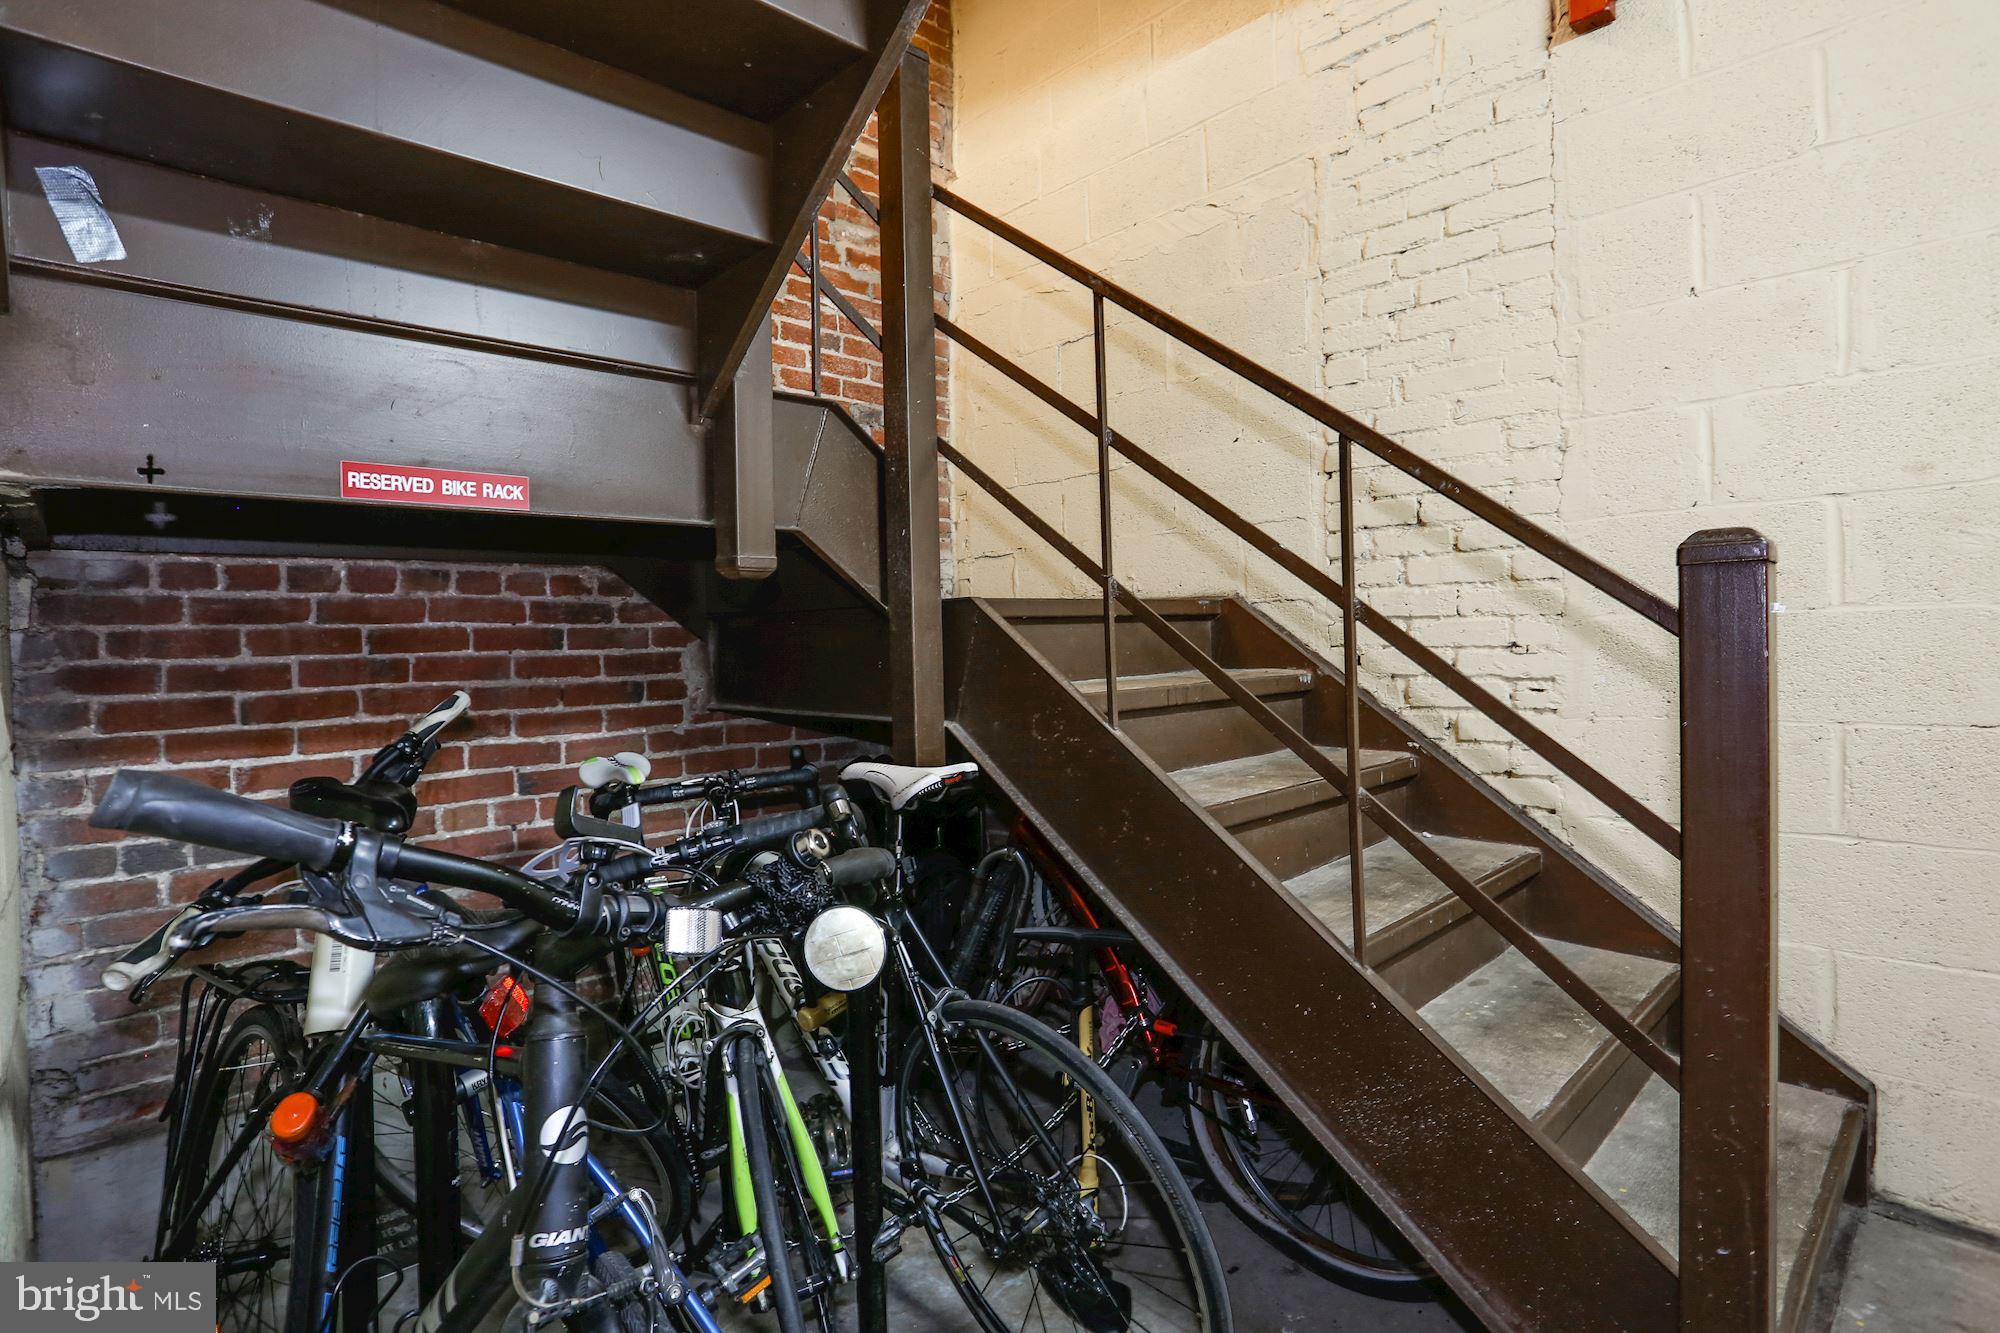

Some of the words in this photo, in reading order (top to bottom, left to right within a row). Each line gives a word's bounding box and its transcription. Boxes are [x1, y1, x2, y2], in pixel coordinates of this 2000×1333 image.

[347, 471, 434, 493] RESERVED
[441, 479, 477, 497] BIKE
[482, 482, 524, 500] RACK
[528, 1225, 589, 1248] GIAN
